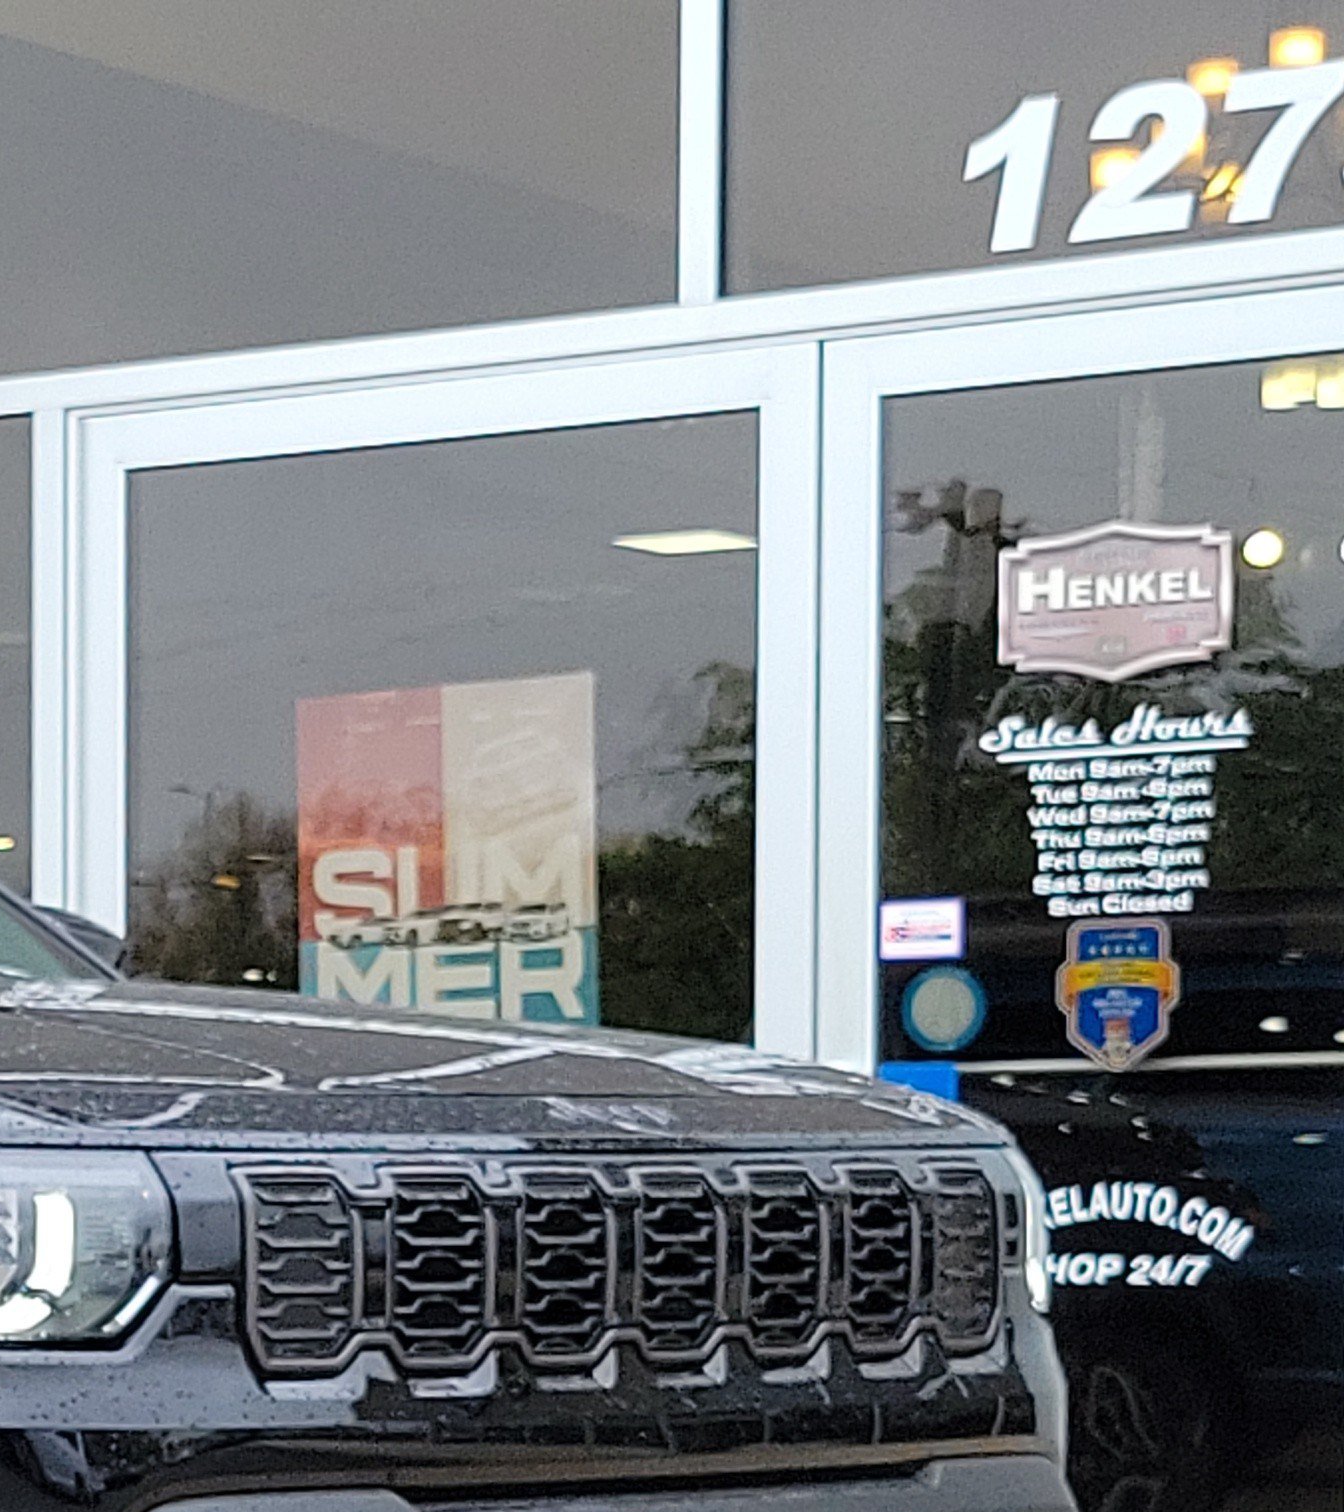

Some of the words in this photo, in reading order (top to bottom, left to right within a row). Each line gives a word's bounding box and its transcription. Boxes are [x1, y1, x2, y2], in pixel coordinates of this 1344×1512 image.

[962, 57, 1344, 254] 127
[1018, 566, 1213, 615] HENKEL
[979, 715, 1104, 752] Sales
[1110, 703, 1254, 746] Hours
[1028, 762, 1086, 783] Mon
[1030, 784, 1078, 805] Tue
[1026, 806, 1087, 828] Wed
[1030, 829, 1082, 850] Thu
[1038, 851, 1076, 872] Fri
[1032, 874, 1082, 896] Sat
[1047, 896, 1100, 918] Sun
[1101, 889, 1194, 914] Closed
[317, 930, 584, 1020] MER
[1044, 1180, 1255, 1262] ELAUTO.COM
[1045, 1252, 1125, 1286] HOP
[1126, 1253, 1212, 1287] 24/7
